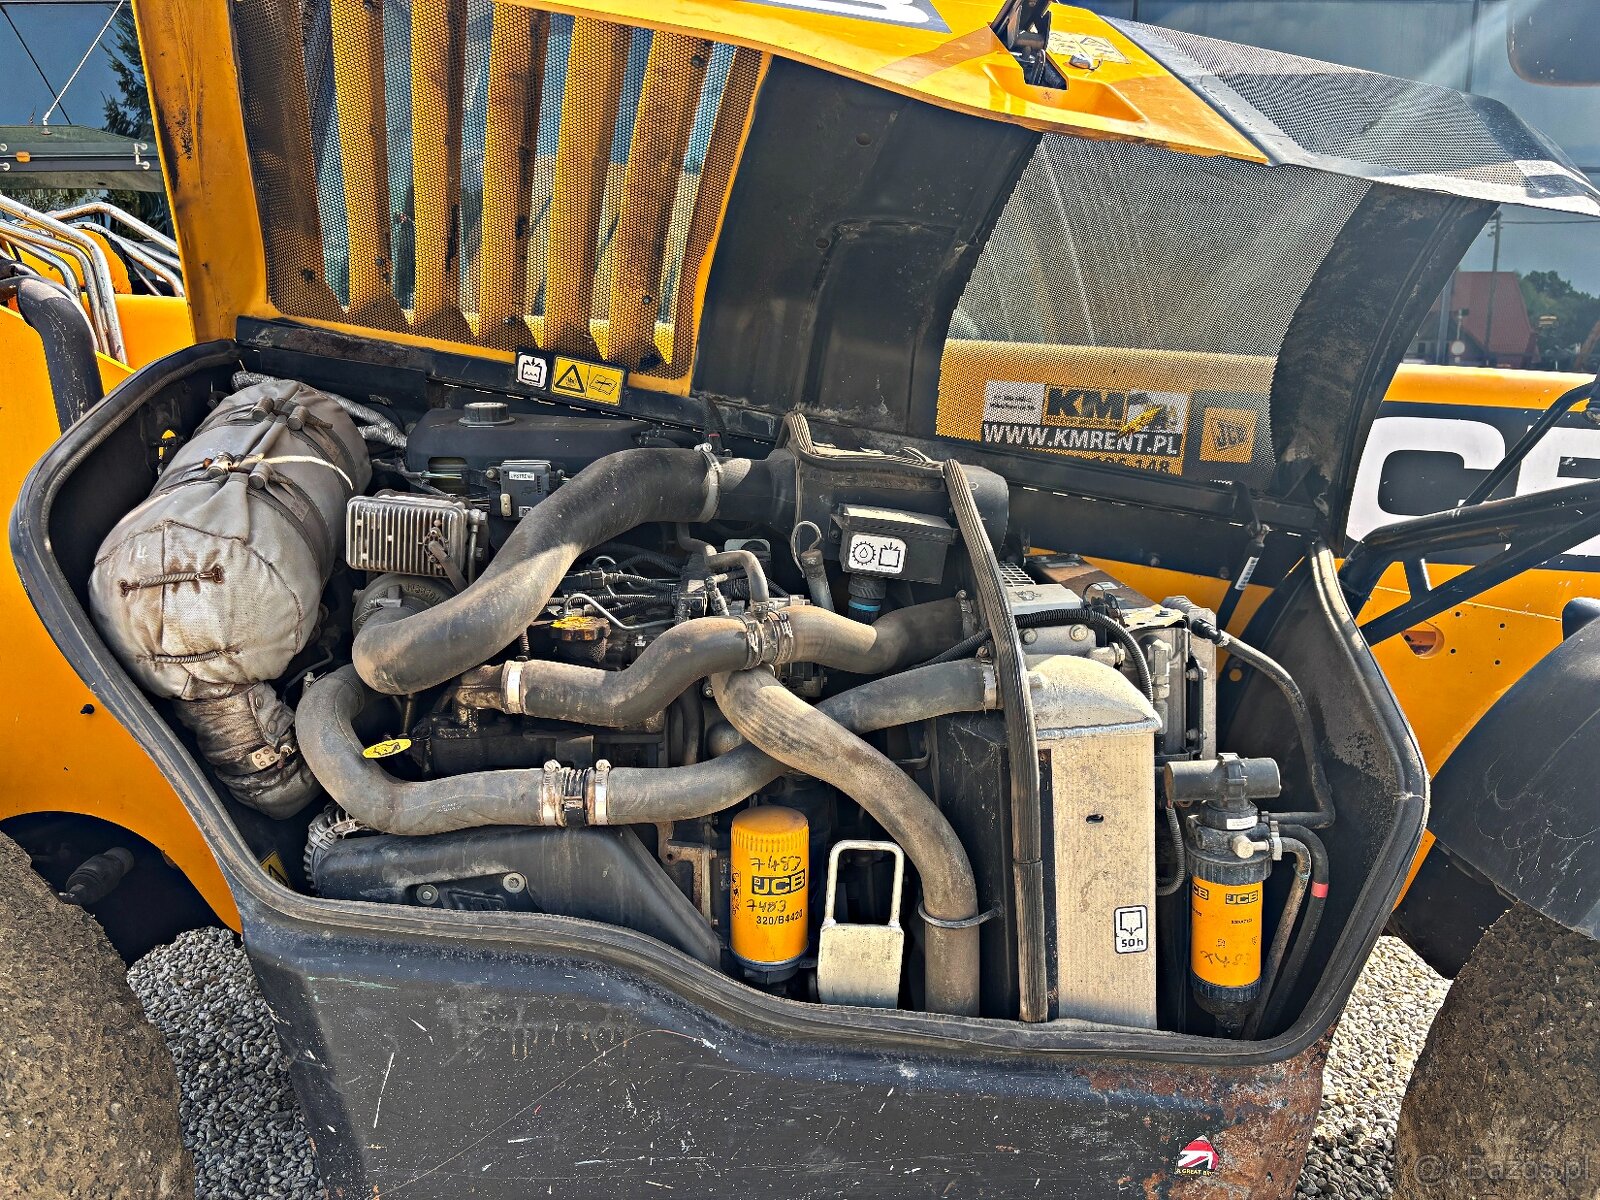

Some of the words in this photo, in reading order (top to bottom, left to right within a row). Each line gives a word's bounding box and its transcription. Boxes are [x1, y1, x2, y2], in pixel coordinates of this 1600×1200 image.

[1047, 389, 1124, 419] KM
[752, 868, 805, 895] JCB
[1226, 890, 1259, 905] JCB
[756, 909, 803, 925] 320/B4420
